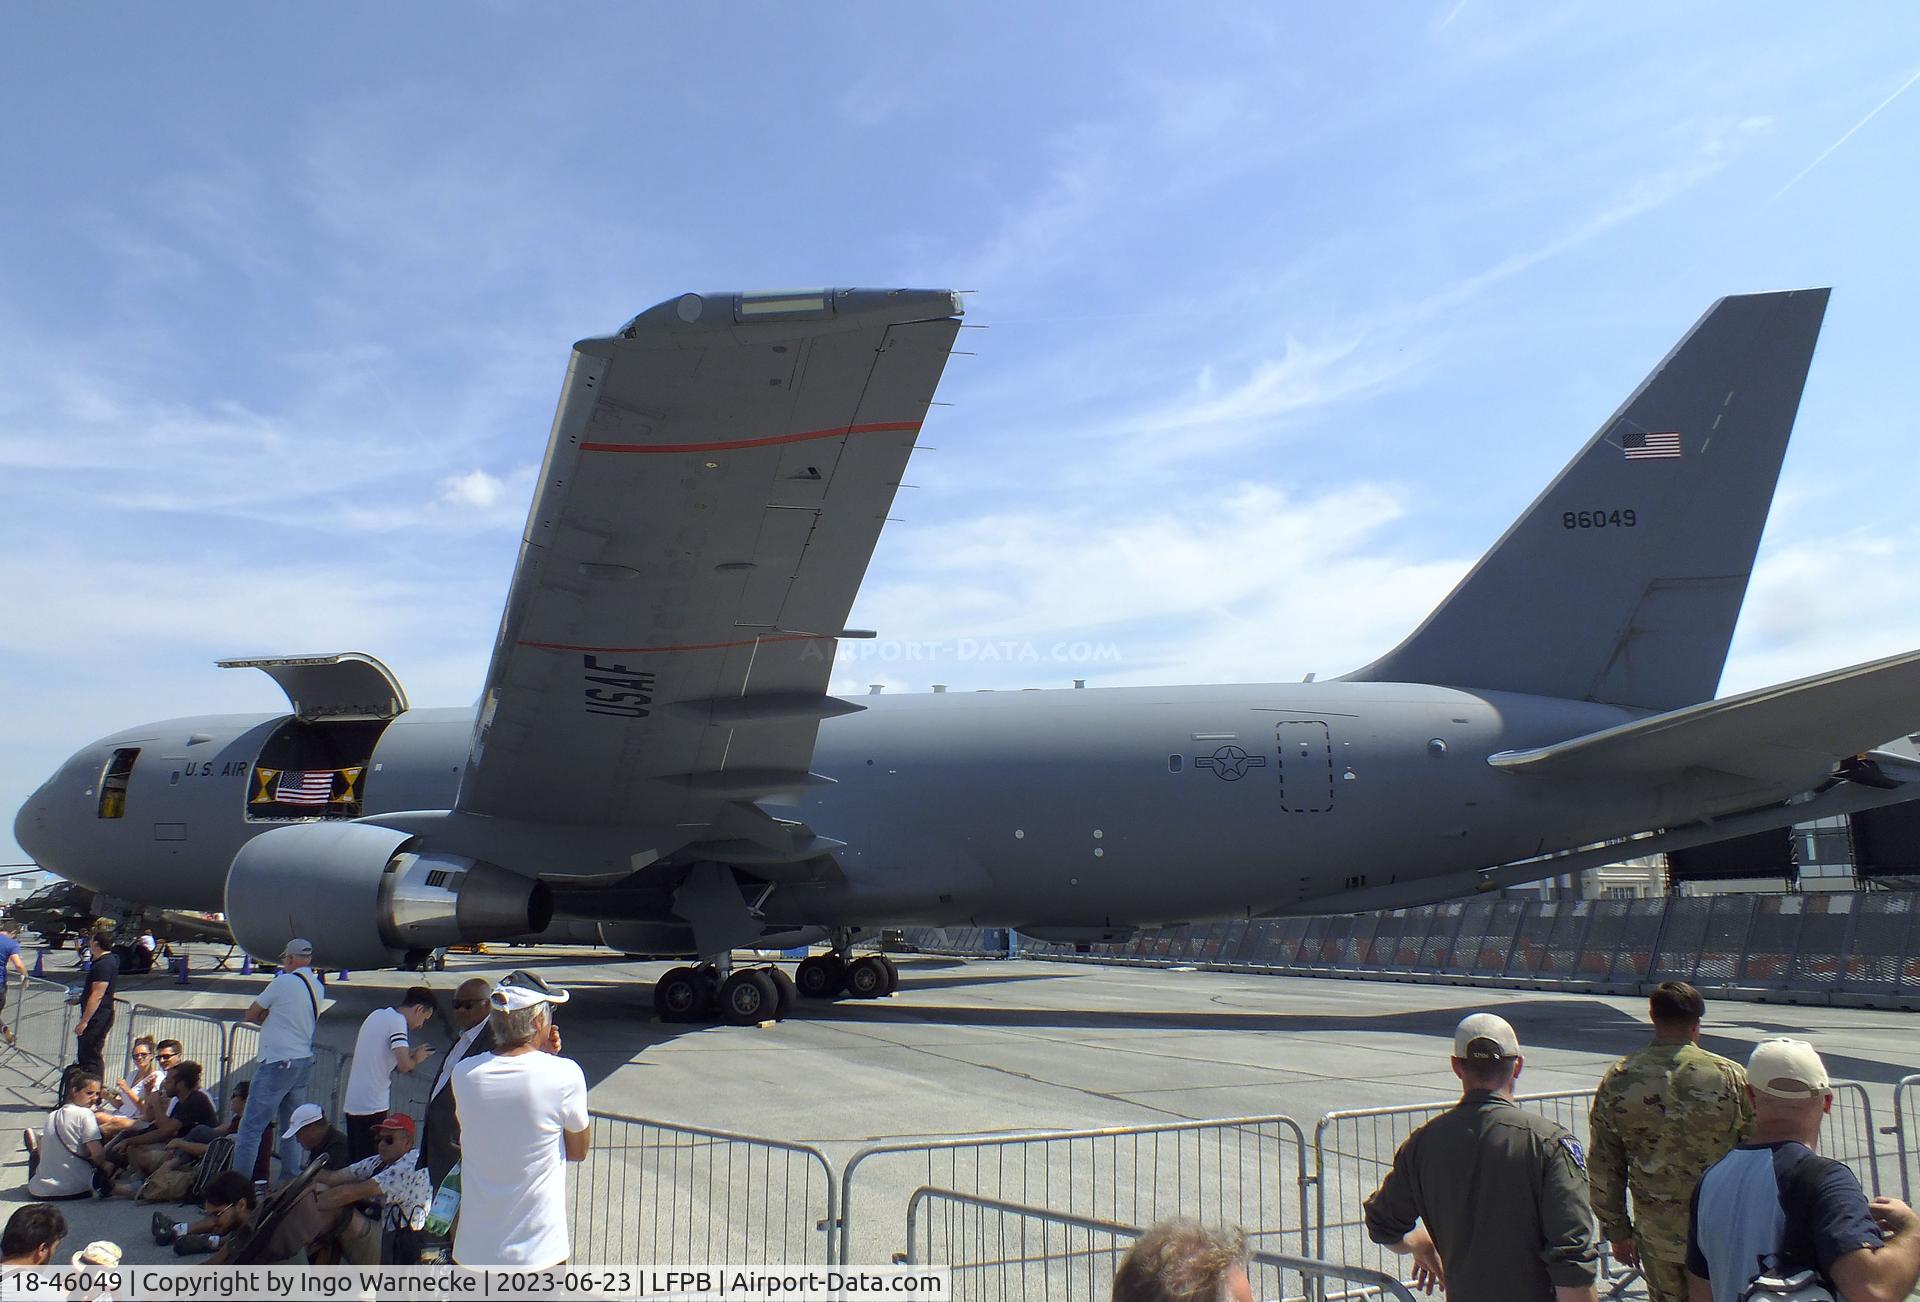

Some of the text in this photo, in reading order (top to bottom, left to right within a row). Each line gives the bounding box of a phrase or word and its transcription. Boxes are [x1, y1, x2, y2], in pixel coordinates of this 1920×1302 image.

[1563, 509, 1637, 529] 86049
[583, 653, 657, 718] USAF
[185, 761, 248, 777] U.S. AIR
